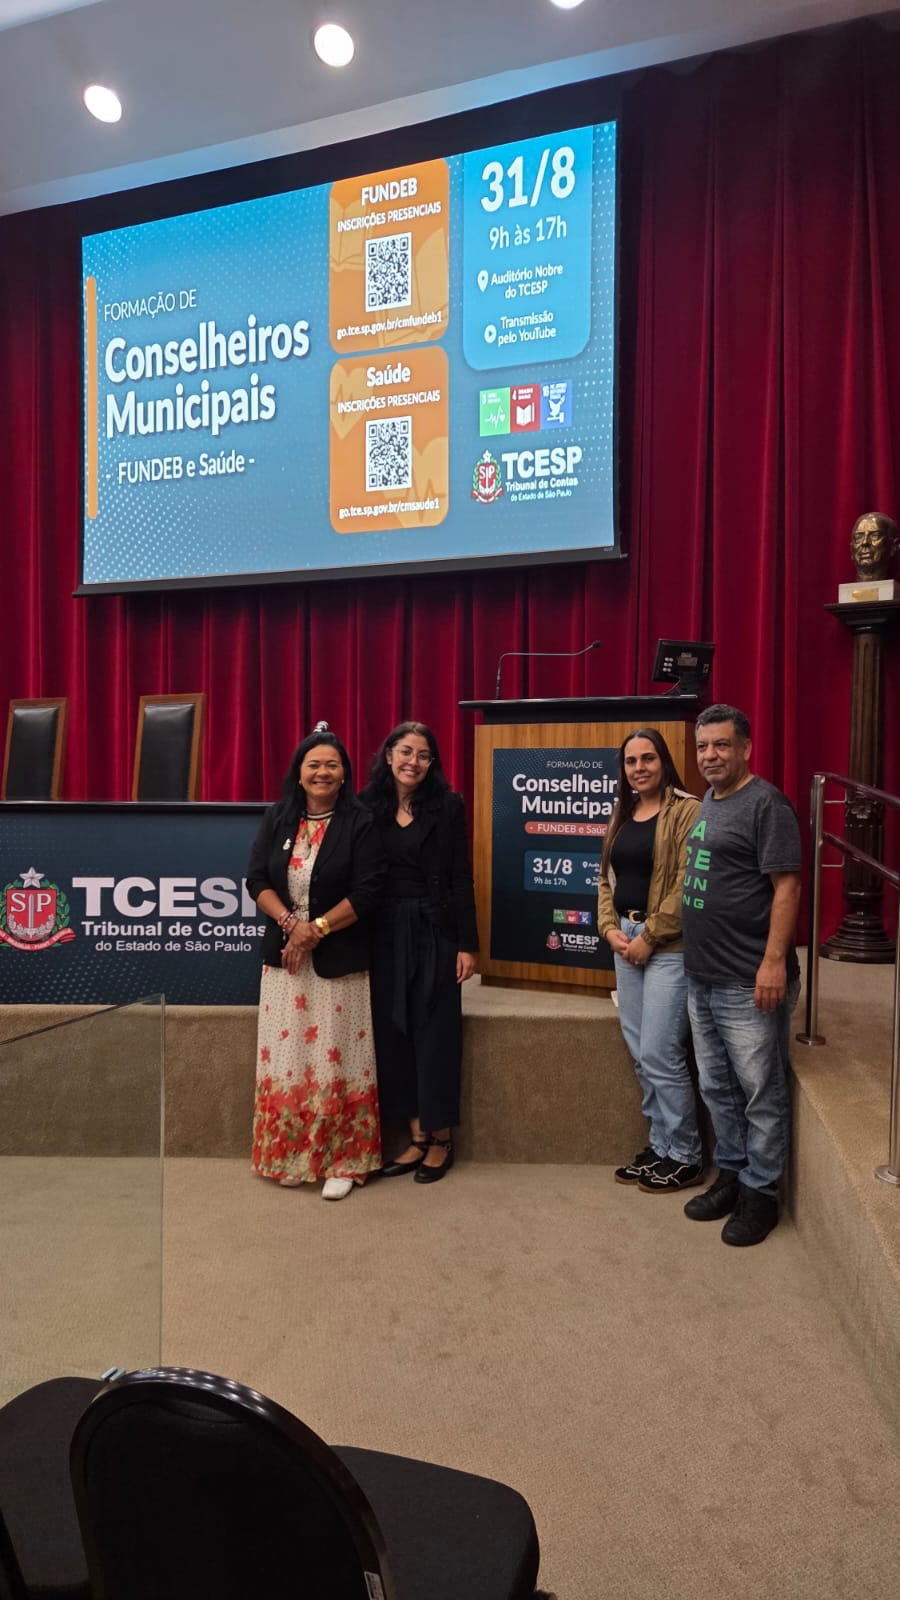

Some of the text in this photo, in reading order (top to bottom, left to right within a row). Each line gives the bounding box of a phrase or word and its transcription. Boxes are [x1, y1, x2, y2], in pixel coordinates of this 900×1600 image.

[481, 146, 576, 213] 31/8
[361, 177, 418, 206] FUNDEB
[337, 201, 442, 233] INSCRIÇÕES PRESENCIAIS
[489, 215, 567, 251] 9h às 17h
[490, 263, 564, 286] Auditório Nobre
[505, 279, 549, 299] do TCESP
[104, 288, 197, 322] FORMAÇÃO DE
[336, 311, 443, 340] go.tce.sp.gov.br/cmfundeb1
[500, 310, 554, 329] Transmissão
[104, 314, 310, 383] Conselheiros
[498, 326, 557, 348] pelo YouTube
[366, 362, 411, 388] Saúde
[106, 372, 276, 439] Municipais
[337, 390, 441, 414] INSCRIÇÕES PRESENCIAIS
[118, 456, 183, 485] FUNDEB
[186, 460, 196, 478] e
[199, 449, 245, 476] Saúde
[501, 445, 583, 480] TCESP
[505, 475, 579, 493] Tribunal de Contas
[546, 760, 604, 770] FORMAÇÃO DE
[512, 773, 618, 794] Conselheir
[521, 794, 619, 819] Municipa
[537, 823, 577, 834] FUNDEB
[578, 826, 584, 834] e
[586, 824, 607, 834] Saúd
[532, 857, 573, 875] 31/8
[533, 876, 543, 885] 9h
[553, 877, 567, 886] 17h
[81, 921, 266, 937] Tribunal de Contas
[560, 933, 600, 946] TCESP
[95, 941, 252, 952] do Estado de São Paulo
